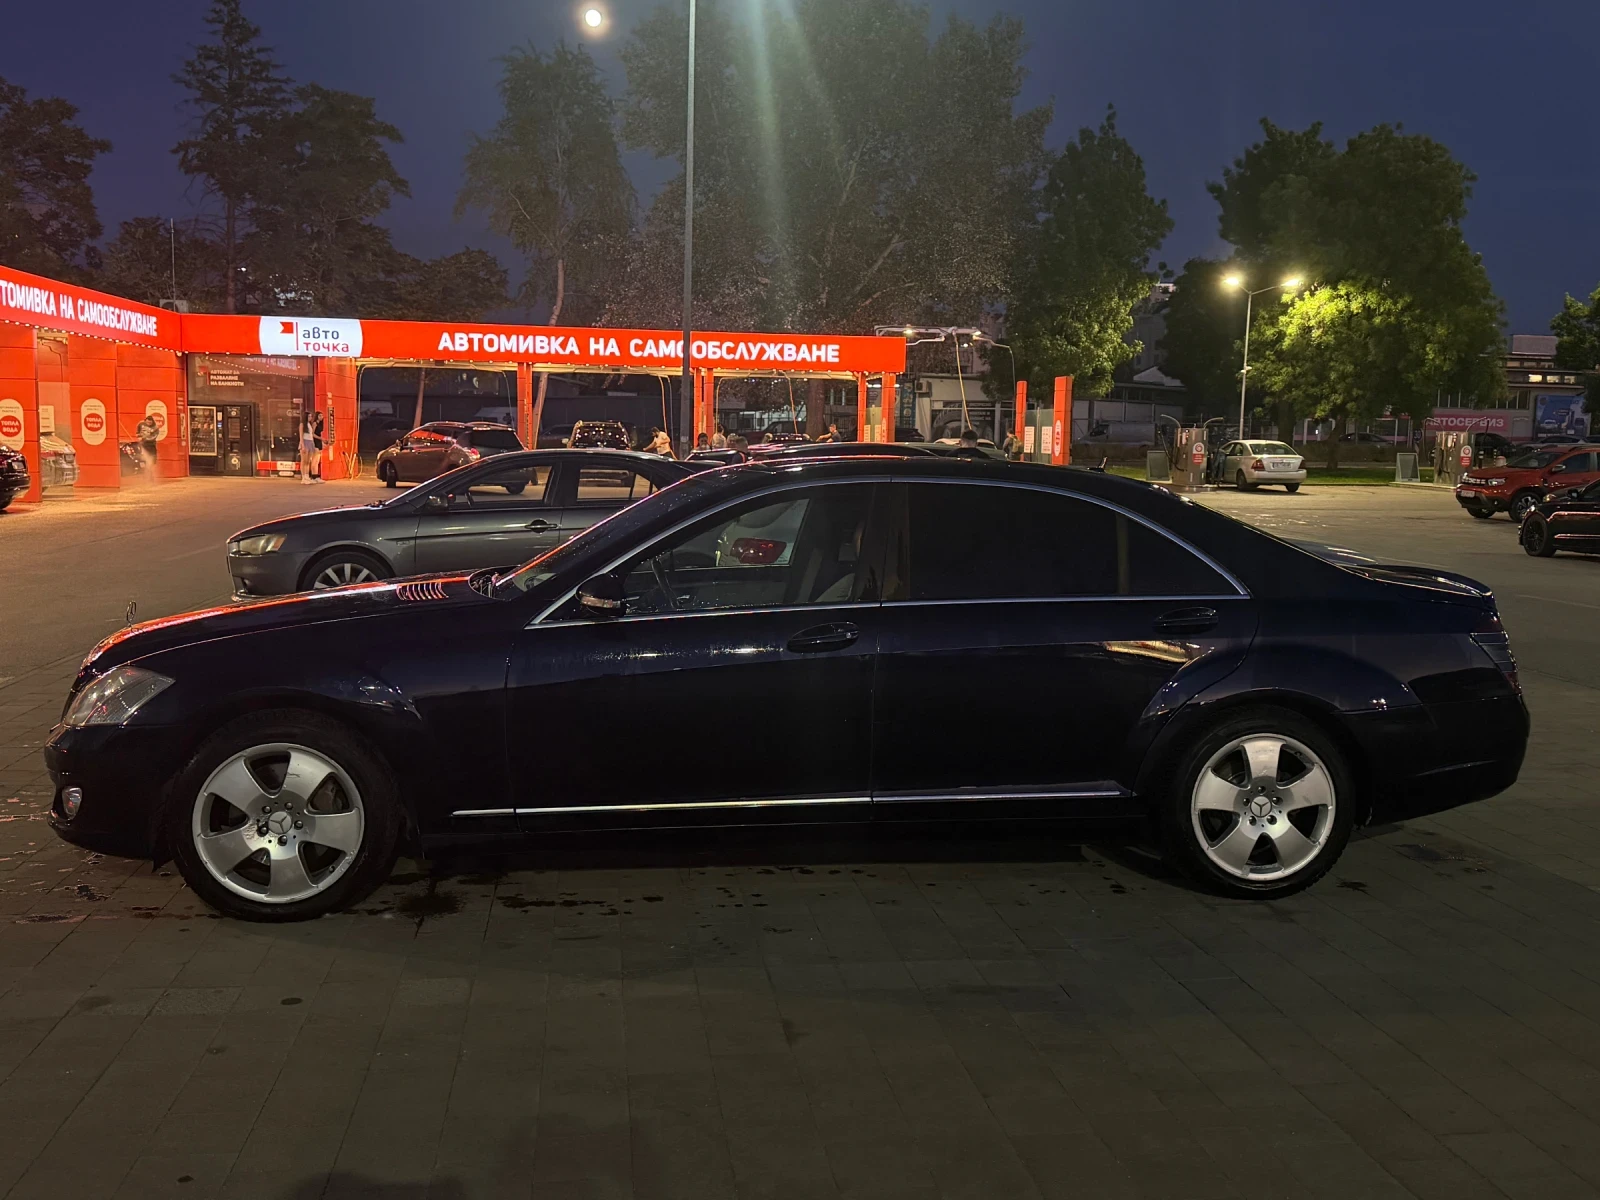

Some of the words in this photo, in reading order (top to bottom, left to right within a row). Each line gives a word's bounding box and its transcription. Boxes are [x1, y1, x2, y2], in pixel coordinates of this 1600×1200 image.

[60, 293, 75, 320] НА
[77, 298, 158, 337] САМООБСЛУЖВАНЕ
[303, 326, 340, 340] авто
[303, 342, 350, 353] точка
[437, 332, 580, 355] АВТОМИВКА
[589, 337, 621, 357] НА
